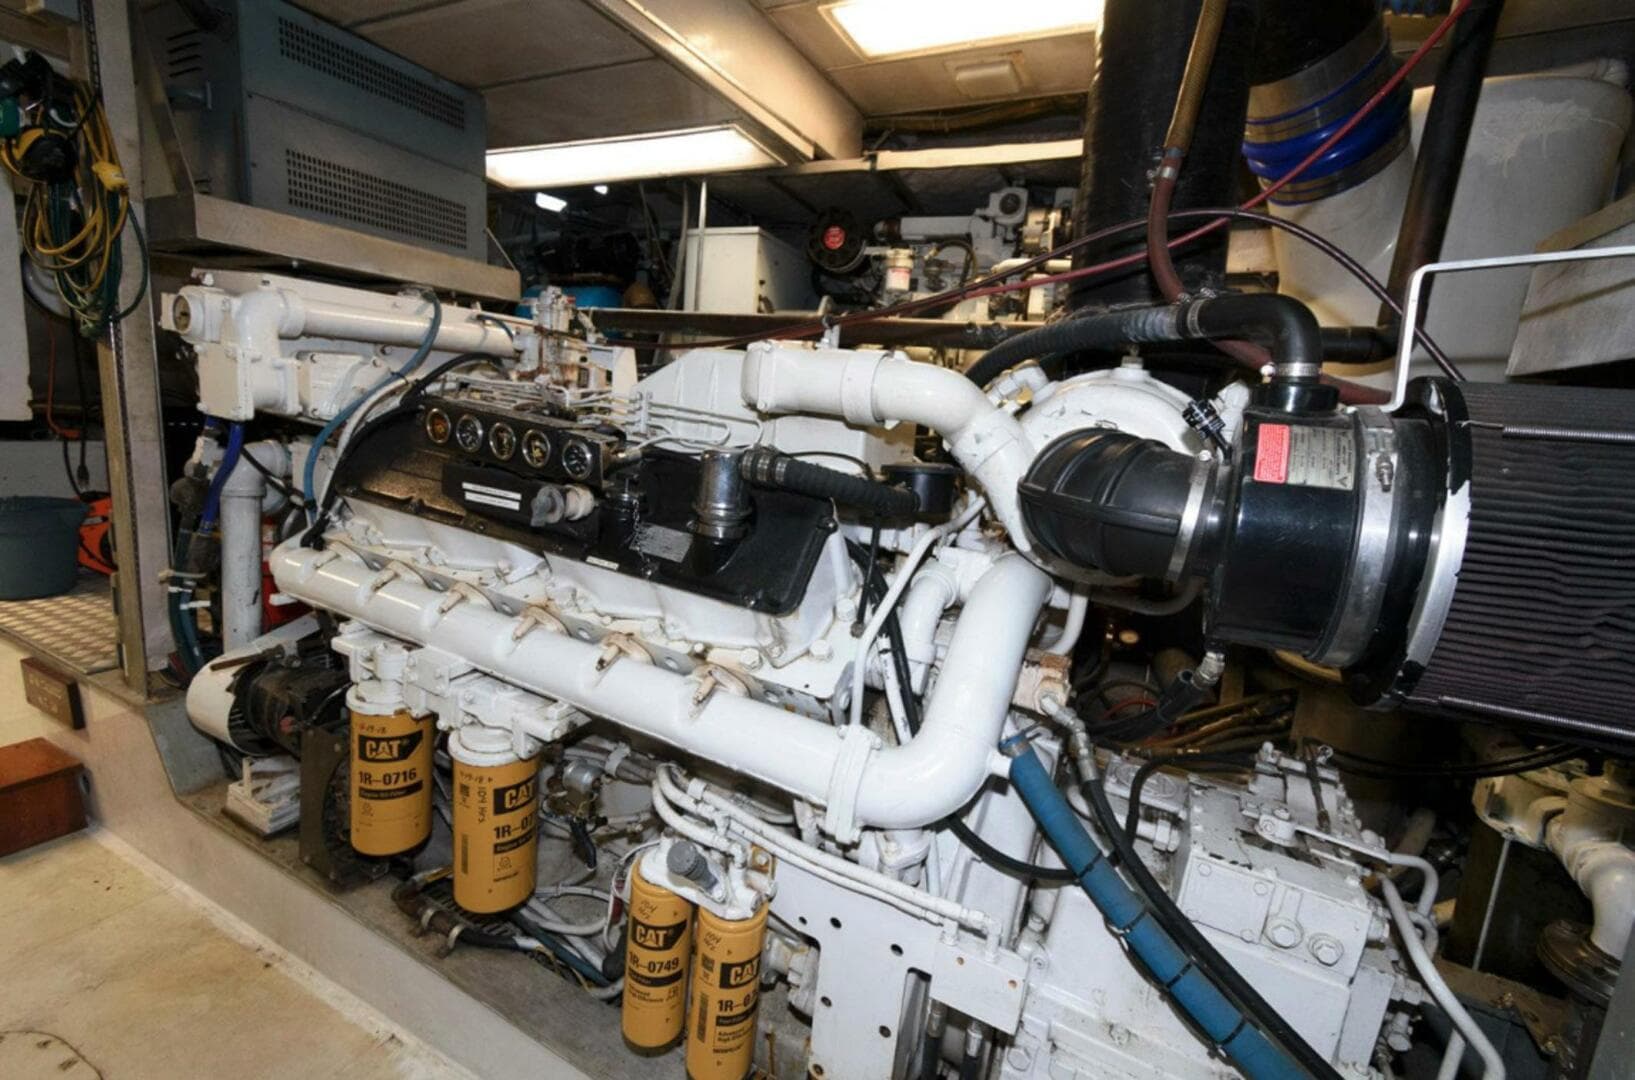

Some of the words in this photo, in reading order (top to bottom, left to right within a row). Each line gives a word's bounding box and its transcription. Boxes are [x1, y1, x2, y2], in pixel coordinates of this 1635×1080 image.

[366, 740, 400, 759] CAT
[359, 768, 417, 785] 1R-0716
[494, 813, 533, 839] 1R-07
[636, 925, 667, 947] CAT
[629, 952, 680, 974] 1R-0749
